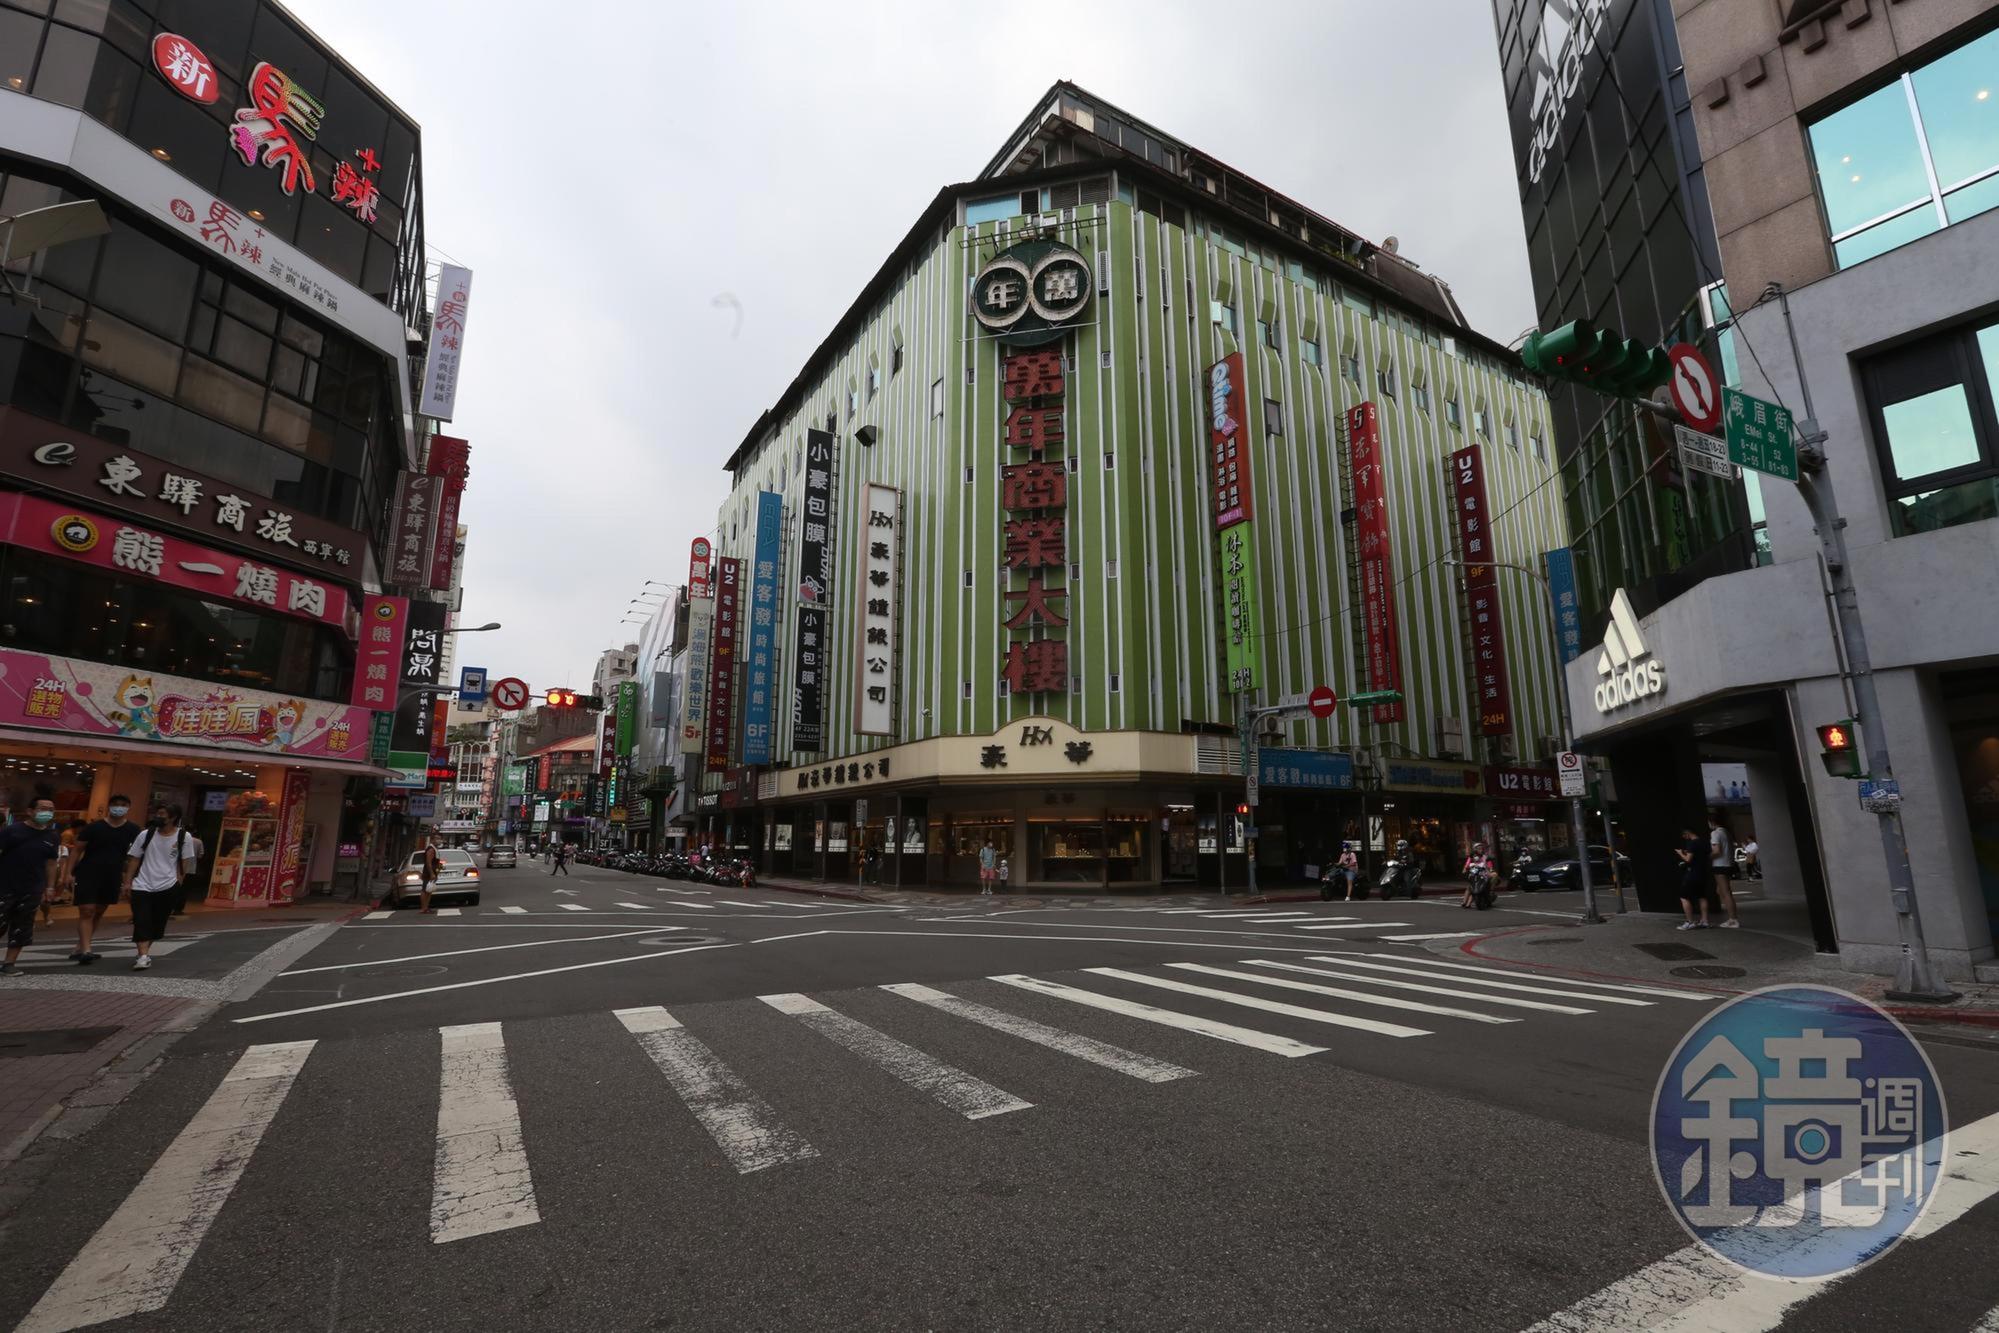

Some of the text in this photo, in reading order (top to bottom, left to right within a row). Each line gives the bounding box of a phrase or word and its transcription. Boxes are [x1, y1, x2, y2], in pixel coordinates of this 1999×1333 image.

[1530, 0, 1612, 184] adida
[1730, 393, 1787, 432] 峨眉街
[1459, 455, 1474, 485] U2
[100, 454, 351, 566] 東驛商旅 西寧館
[805, 443, 829, 544] 小豪包膜
[397, 493, 426, 573] 東驛商旅
[1002, 352, 1067, 694] 萬年商業大樓
[1464, 497, 1481, 552] 電影館
[112, 526, 327, 618] 熊一燒肉
[690, 561, 707, 598] 萬年
[724, 563, 735, 585] U2
[1470, 566, 1485, 578] 9F
[722, 595, 732, 638] 電影館
[365, 625, 391, 703] 熊一燒肉
[407, 628, 437, 677] 問鼎
[801, 613, 817, 686] 小豪包膜
[34, 678, 66, 692] 24H
[1594, 658, 1666, 713] adidas
[332, 721, 351, 731] 24H
[684, 725, 702, 739] 5F
[747, 723, 768, 738] 6F
[1482, 712, 1505, 726] 24H
[710, 757, 726, 766] 24H
[981, 741, 1094, 769] 豪 華
[1500, 773, 1518, 789] U2
